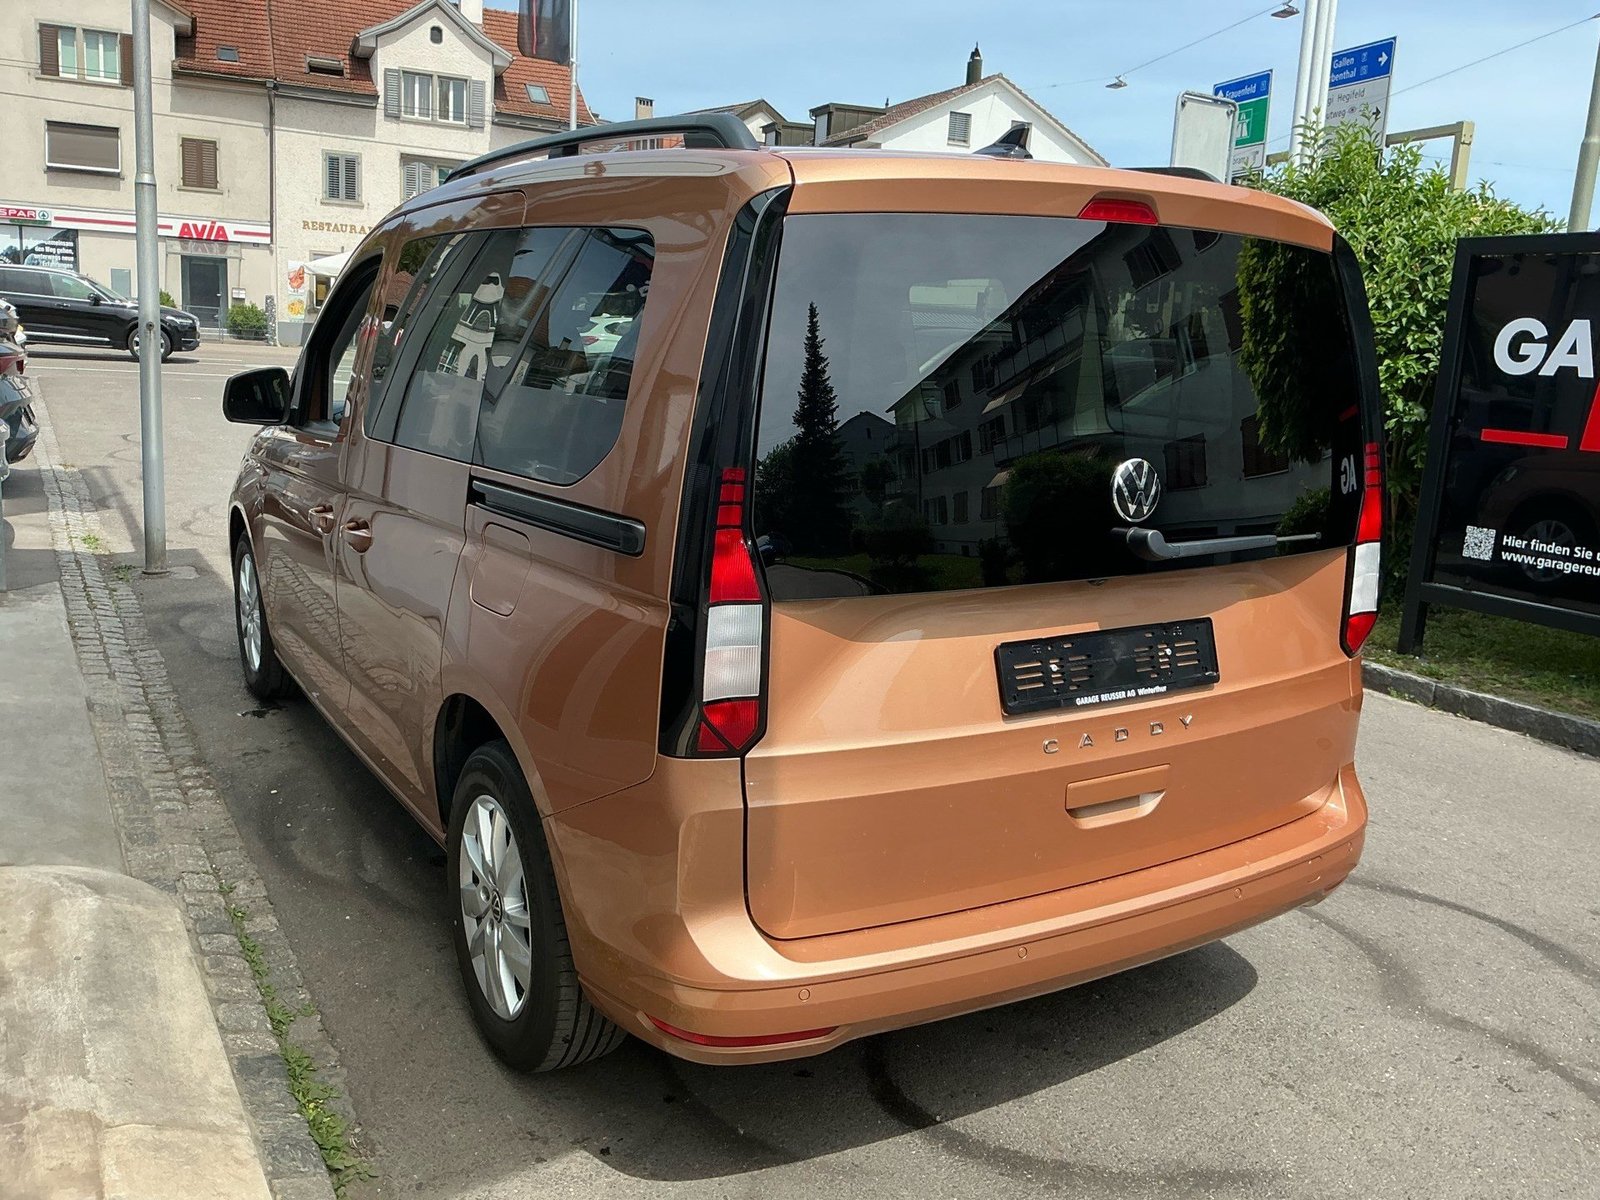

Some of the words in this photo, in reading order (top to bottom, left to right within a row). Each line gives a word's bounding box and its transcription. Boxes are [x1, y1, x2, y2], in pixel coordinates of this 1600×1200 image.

[1333, 57, 1355, 69] Gallen
[1329, 67, 1357, 82] benthal
[1225, 83, 1257, 98] Frauenfeld
[0, 208, 36, 217] SPAR
[302, 220, 372, 235] RESTAURA
[1493, 317, 1594, 378] GA
[1502, 534, 1528, 549] Hier
[1530, 538, 1570, 556] finden
[1573, 546, 1593, 559] Sie
[1076, 694, 1099, 706] GARAGE
[1100, 690, 1127, 702] REUSSER
[1127, 689, 1136, 698] AG
[1138, 685, 1167, 696] Winterthur
[1043, 715, 1192, 754] CADDY
